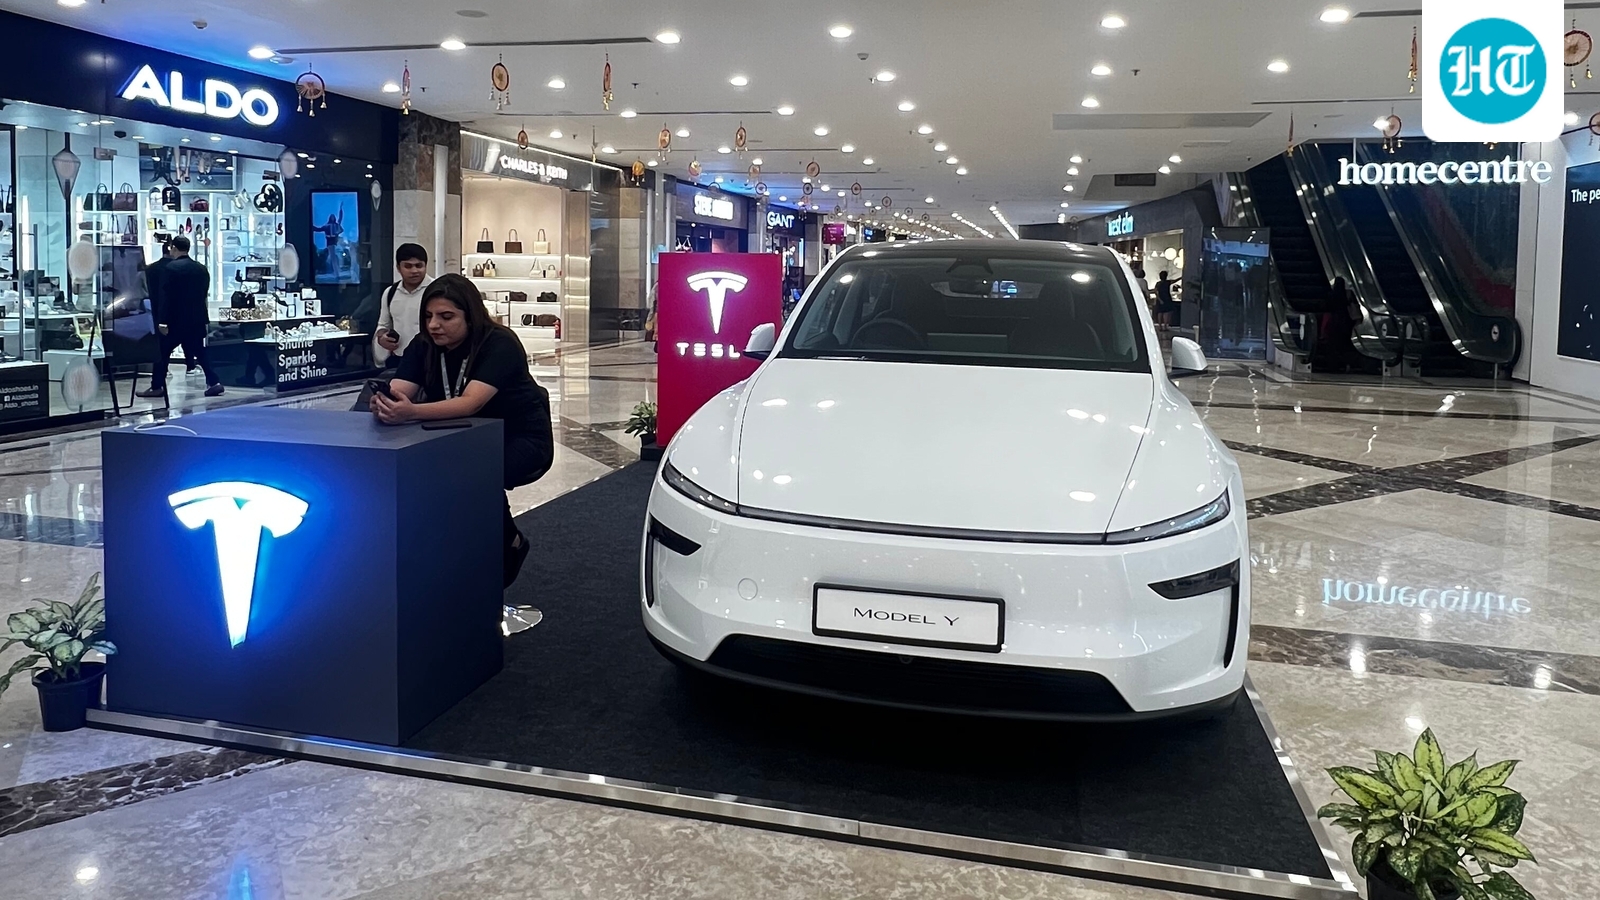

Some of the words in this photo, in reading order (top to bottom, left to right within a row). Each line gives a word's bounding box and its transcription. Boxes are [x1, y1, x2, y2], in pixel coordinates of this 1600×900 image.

[121, 63, 279, 126] ALDO
[500, 154, 539, 175] CHARLES
[1337, 155, 1553, 185] homecentre
[1571, 189, 1588, 203] The
[767, 211, 795, 228] GANT
[278, 350, 317, 369] Sparkle
[676, 342, 741, 358] TESL
[278, 367, 298, 382] and
[300, 365, 328, 379] Shine
[853, 607, 936, 625] MODEL
[944, 615, 960, 626] Y
